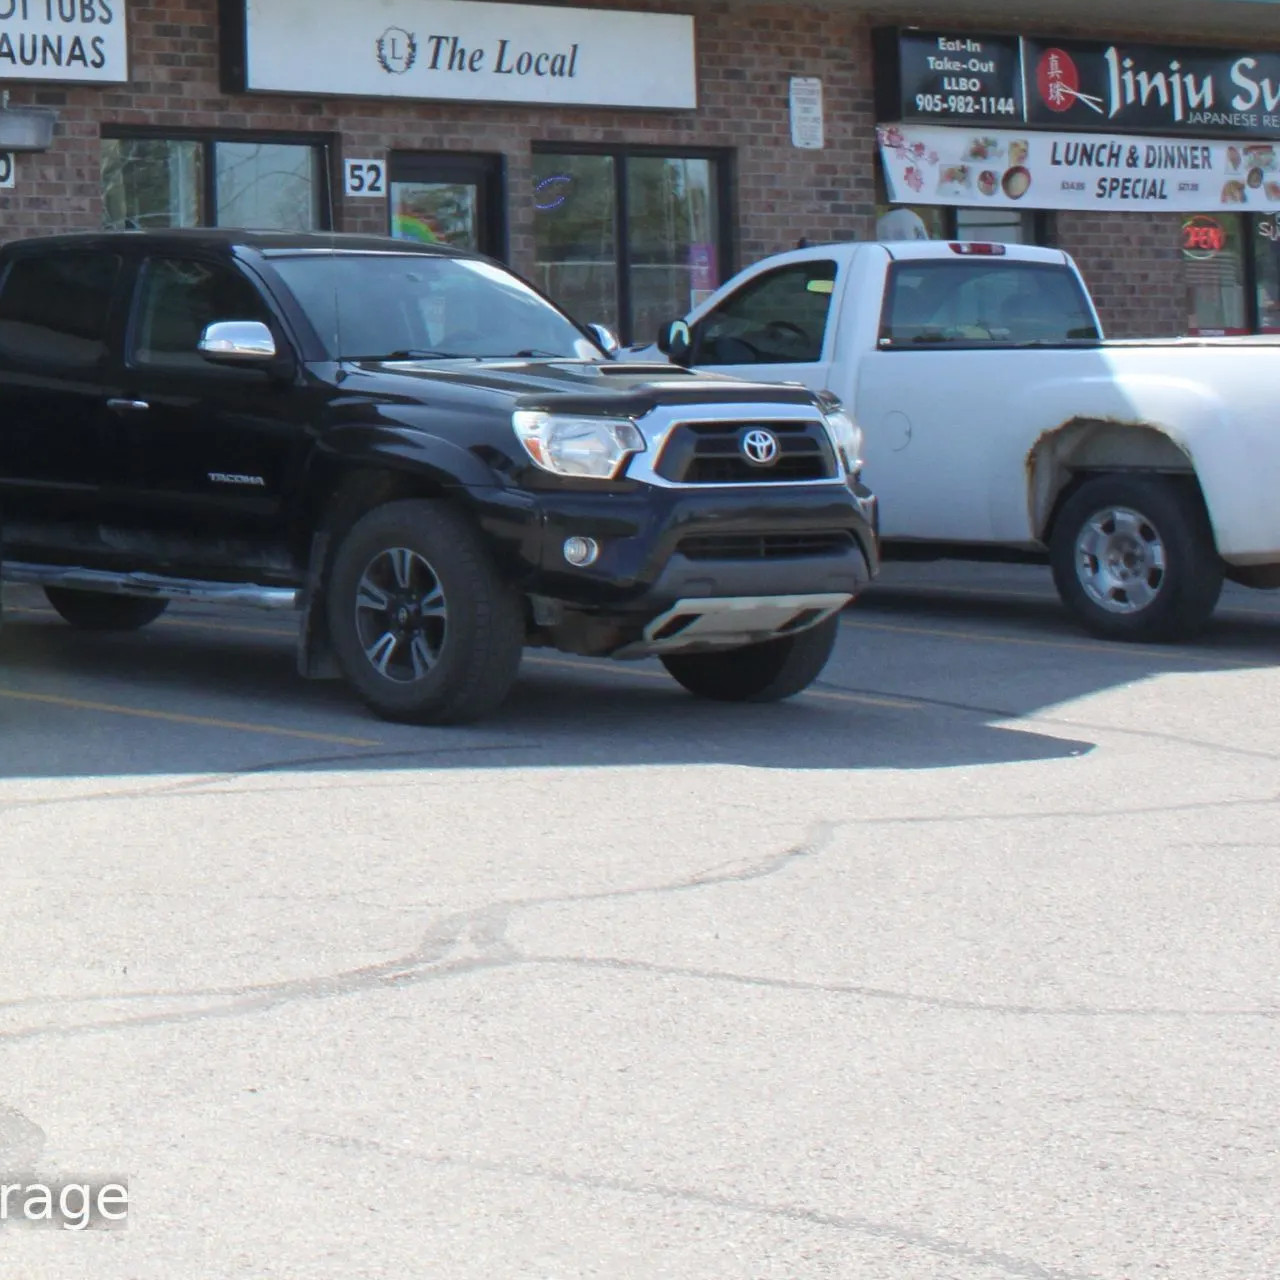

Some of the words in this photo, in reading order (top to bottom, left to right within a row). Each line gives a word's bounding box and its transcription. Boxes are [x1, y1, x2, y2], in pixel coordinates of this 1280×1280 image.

[938, 38, 981, 52] Eat-In
[427, 35, 485, 72] The
[493, 39, 579, 78] Local
[927, 57, 995, 72] Take-Out
[943, 77, 981, 92] LLBO
[1104, 46, 1214, 122] Jinju
[915, 94, 1015, 115] 905-982-1144
[1187, 111, 1258, 128] JAPANESE
[1050, 140, 1122, 168] LUNCH
[1125, 144, 1139, 168] &
[1144, 144, 1213, 170] DINNER
[349, 164, 382, 192] 52
[1095, 177, 1168, 200] SPECIAL
